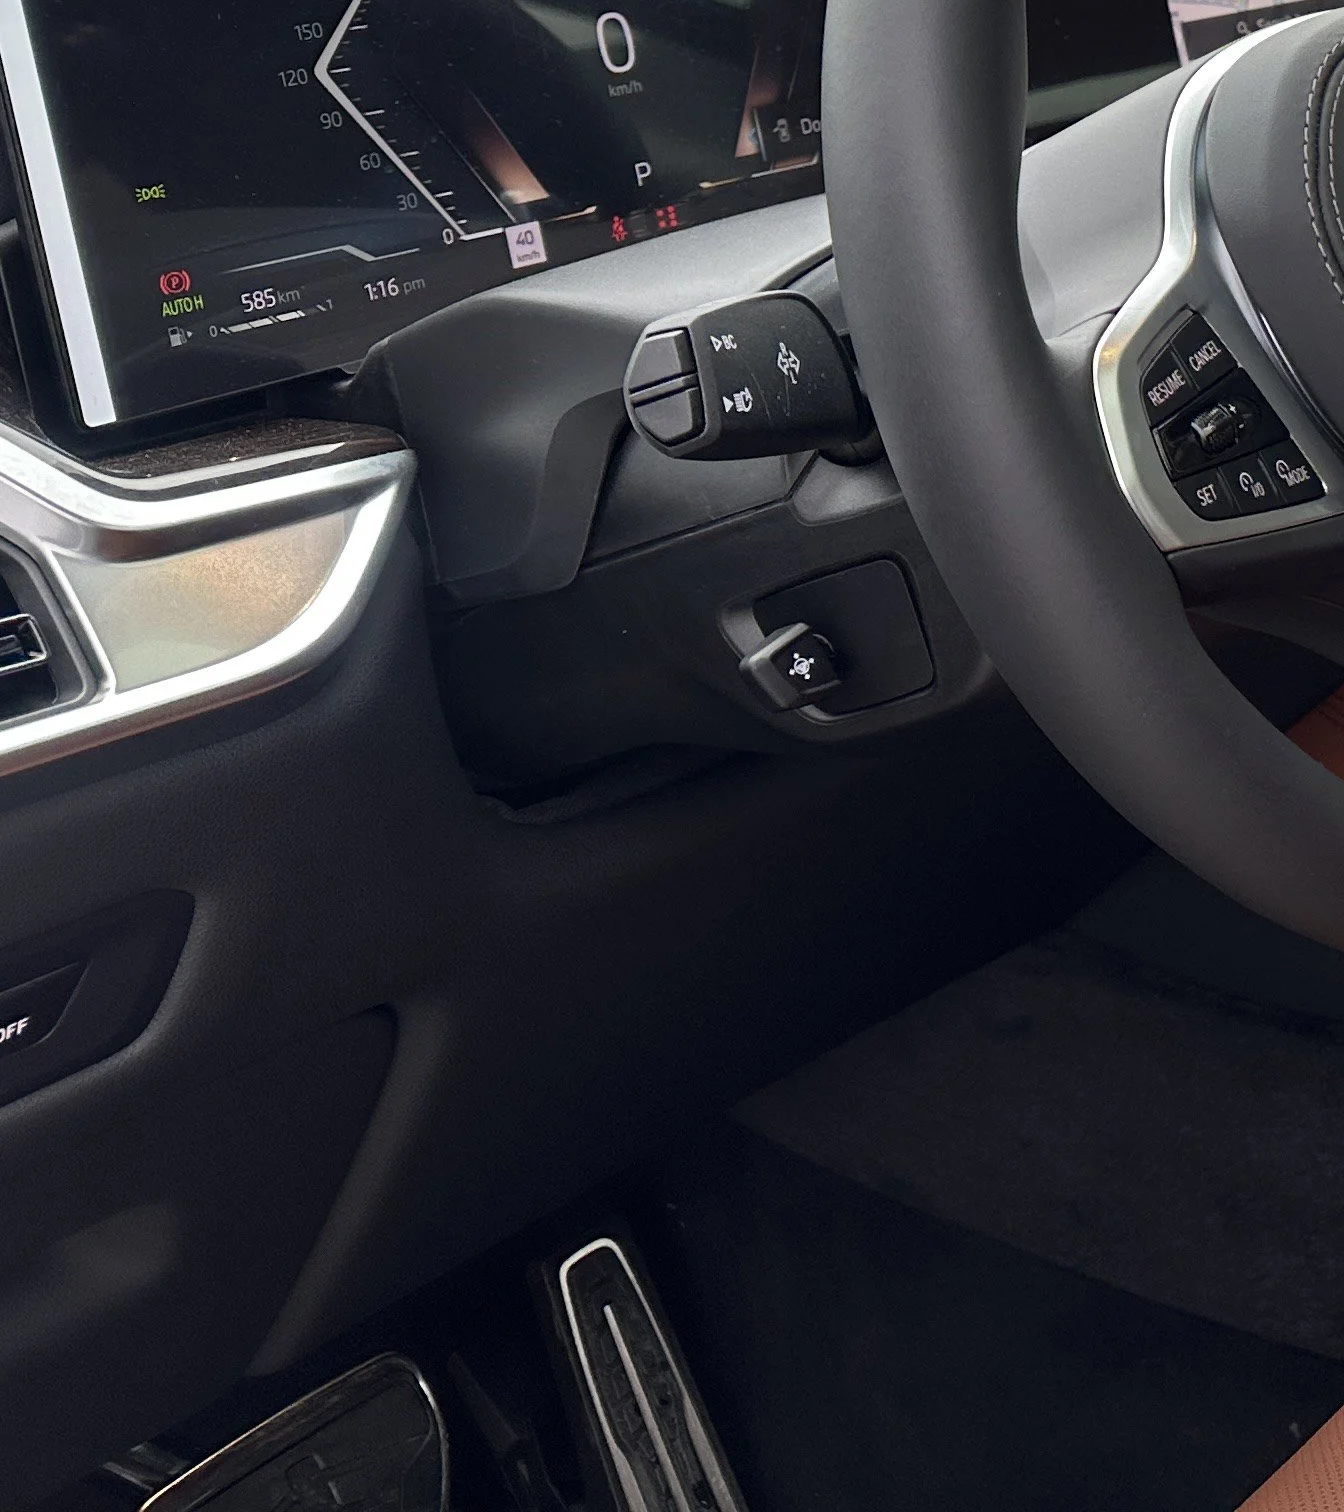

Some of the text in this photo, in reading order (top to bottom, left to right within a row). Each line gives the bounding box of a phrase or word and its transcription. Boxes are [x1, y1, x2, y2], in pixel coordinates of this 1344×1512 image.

[293, 22, 324, 41] 150
[596, 11, 636, 74] 0
[278, 68, 309, 88] 120
[608, 80, 643, 98] km/h
[319, 111, 344, 130] 90
[359, 152, 382, 171] 60
[634, 161, 652, 187] P
[396, 192, 419, 211] 30
[442, 228, 455, 245] 0
[516, 229, 536, 246] 40
[516, 249, 541, 263] km/h
[364, 276, 426, 303] 1:16 pm
[162, 294, 205, 318] AUTO H
[240, 288, 301, 313] 585 km
[208, 325, 218, 338] 0
[721, 334, 738, 350] BC
[1188, 340, 1222, 372] CANCEL
[1147, 369, 1187, 407] RESUME
[1285, 465, 1311, 488] MODE
[1196, 484, 1218, 507] SET
